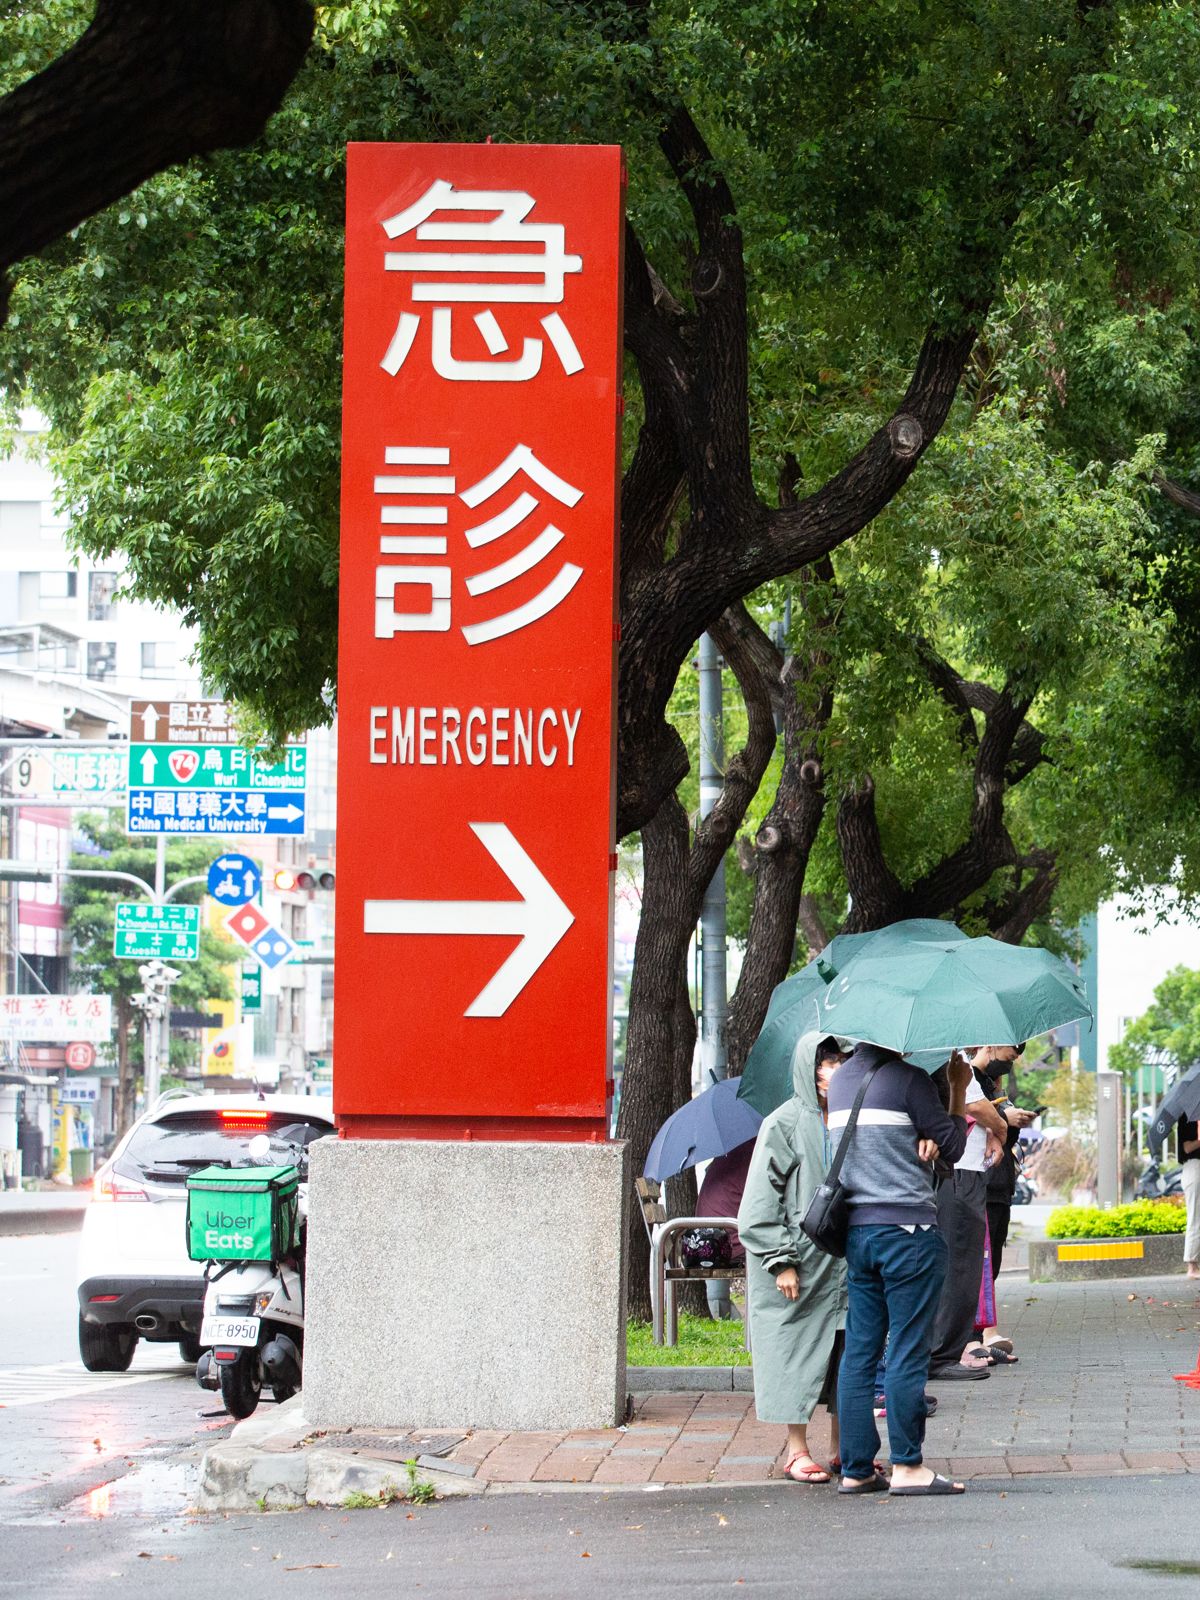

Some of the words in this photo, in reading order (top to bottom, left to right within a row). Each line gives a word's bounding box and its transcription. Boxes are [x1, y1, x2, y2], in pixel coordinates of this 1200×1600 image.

[374, 179, 585, 646] 急診
[169, 703, 232, 727] 國立臺
[370, 706, 582, 767] EMERGENCY
[173, 753, 195, 770] 74
[213, 773, 237, 786] Wuri
[255, 773, 304, 788] Changhua
[132, 791, 267, 817] 中國醫藥大學
[130, 817, 160, 831] China
[164, 817, 205, 831] Medical
[209, 817, 267, 833] University
[125, 932, 188, 947] 學士路
[125, 945, 160, 956] Xueshi
[206, 1210, 255, 1229] Uber
[205, 1230, 254, 1249] Eats
